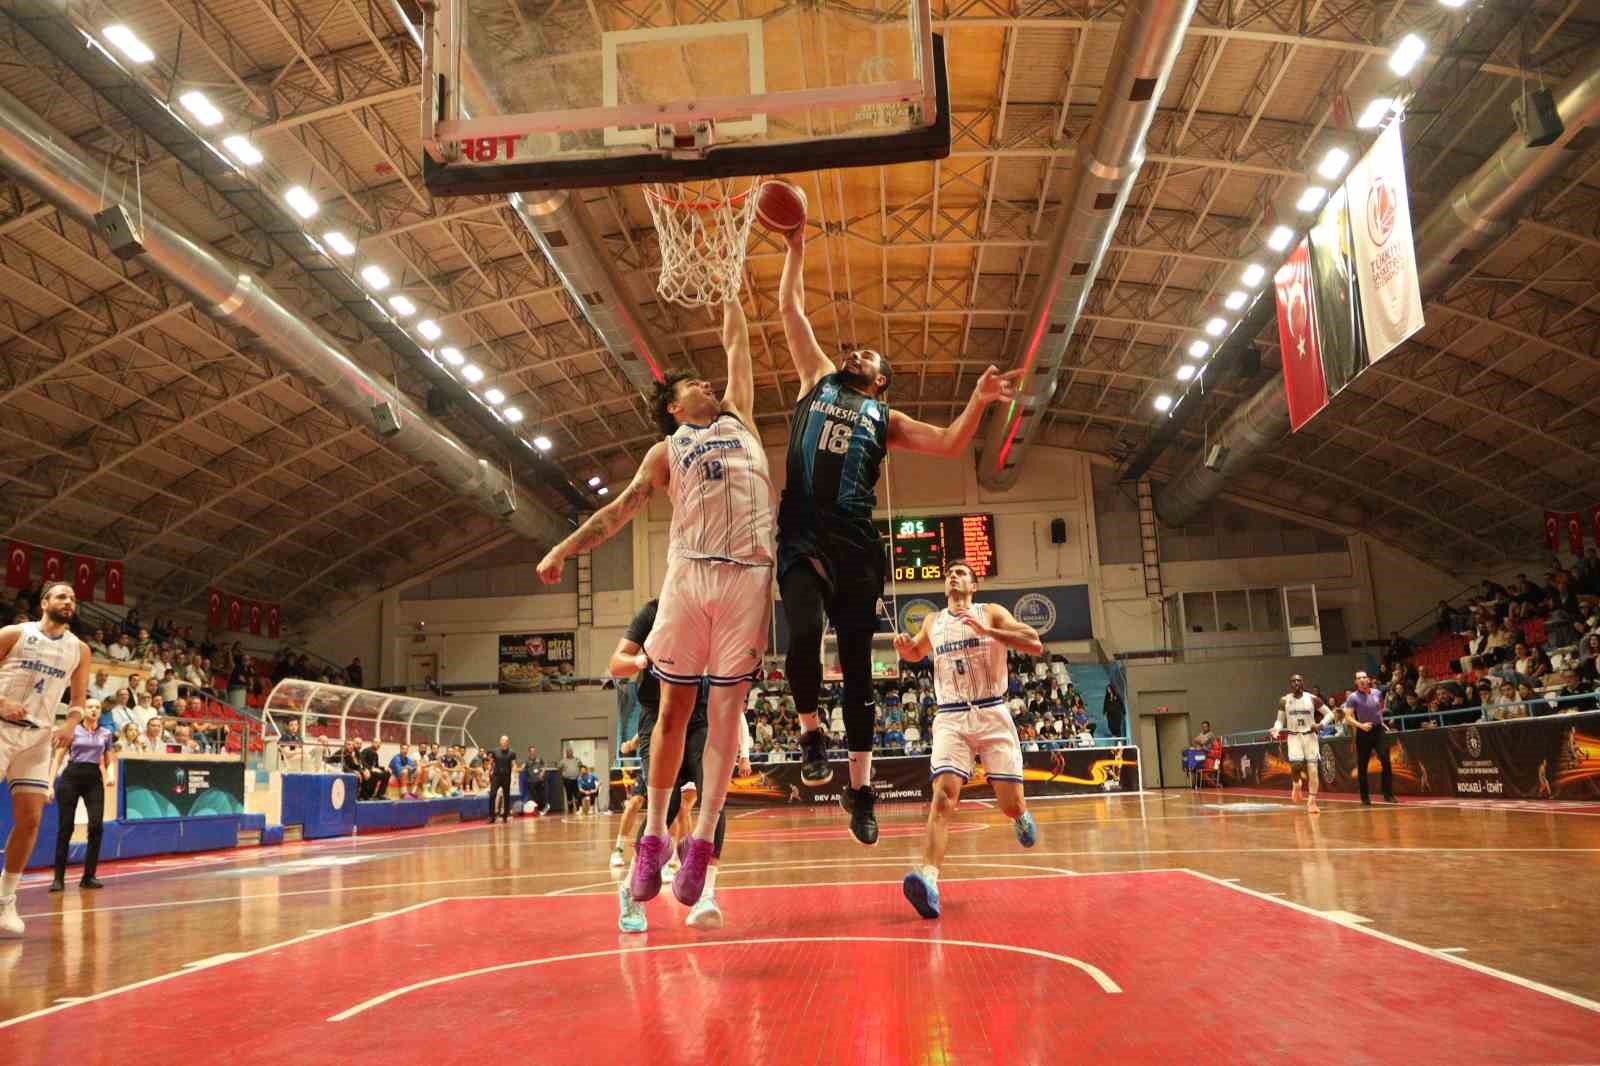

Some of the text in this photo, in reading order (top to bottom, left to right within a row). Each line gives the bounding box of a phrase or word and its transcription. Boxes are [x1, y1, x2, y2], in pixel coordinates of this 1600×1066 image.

[819, 420, 852, 454] 18
[703, 460, 721, 480] 12
[34, 678, 45, 695] 4
